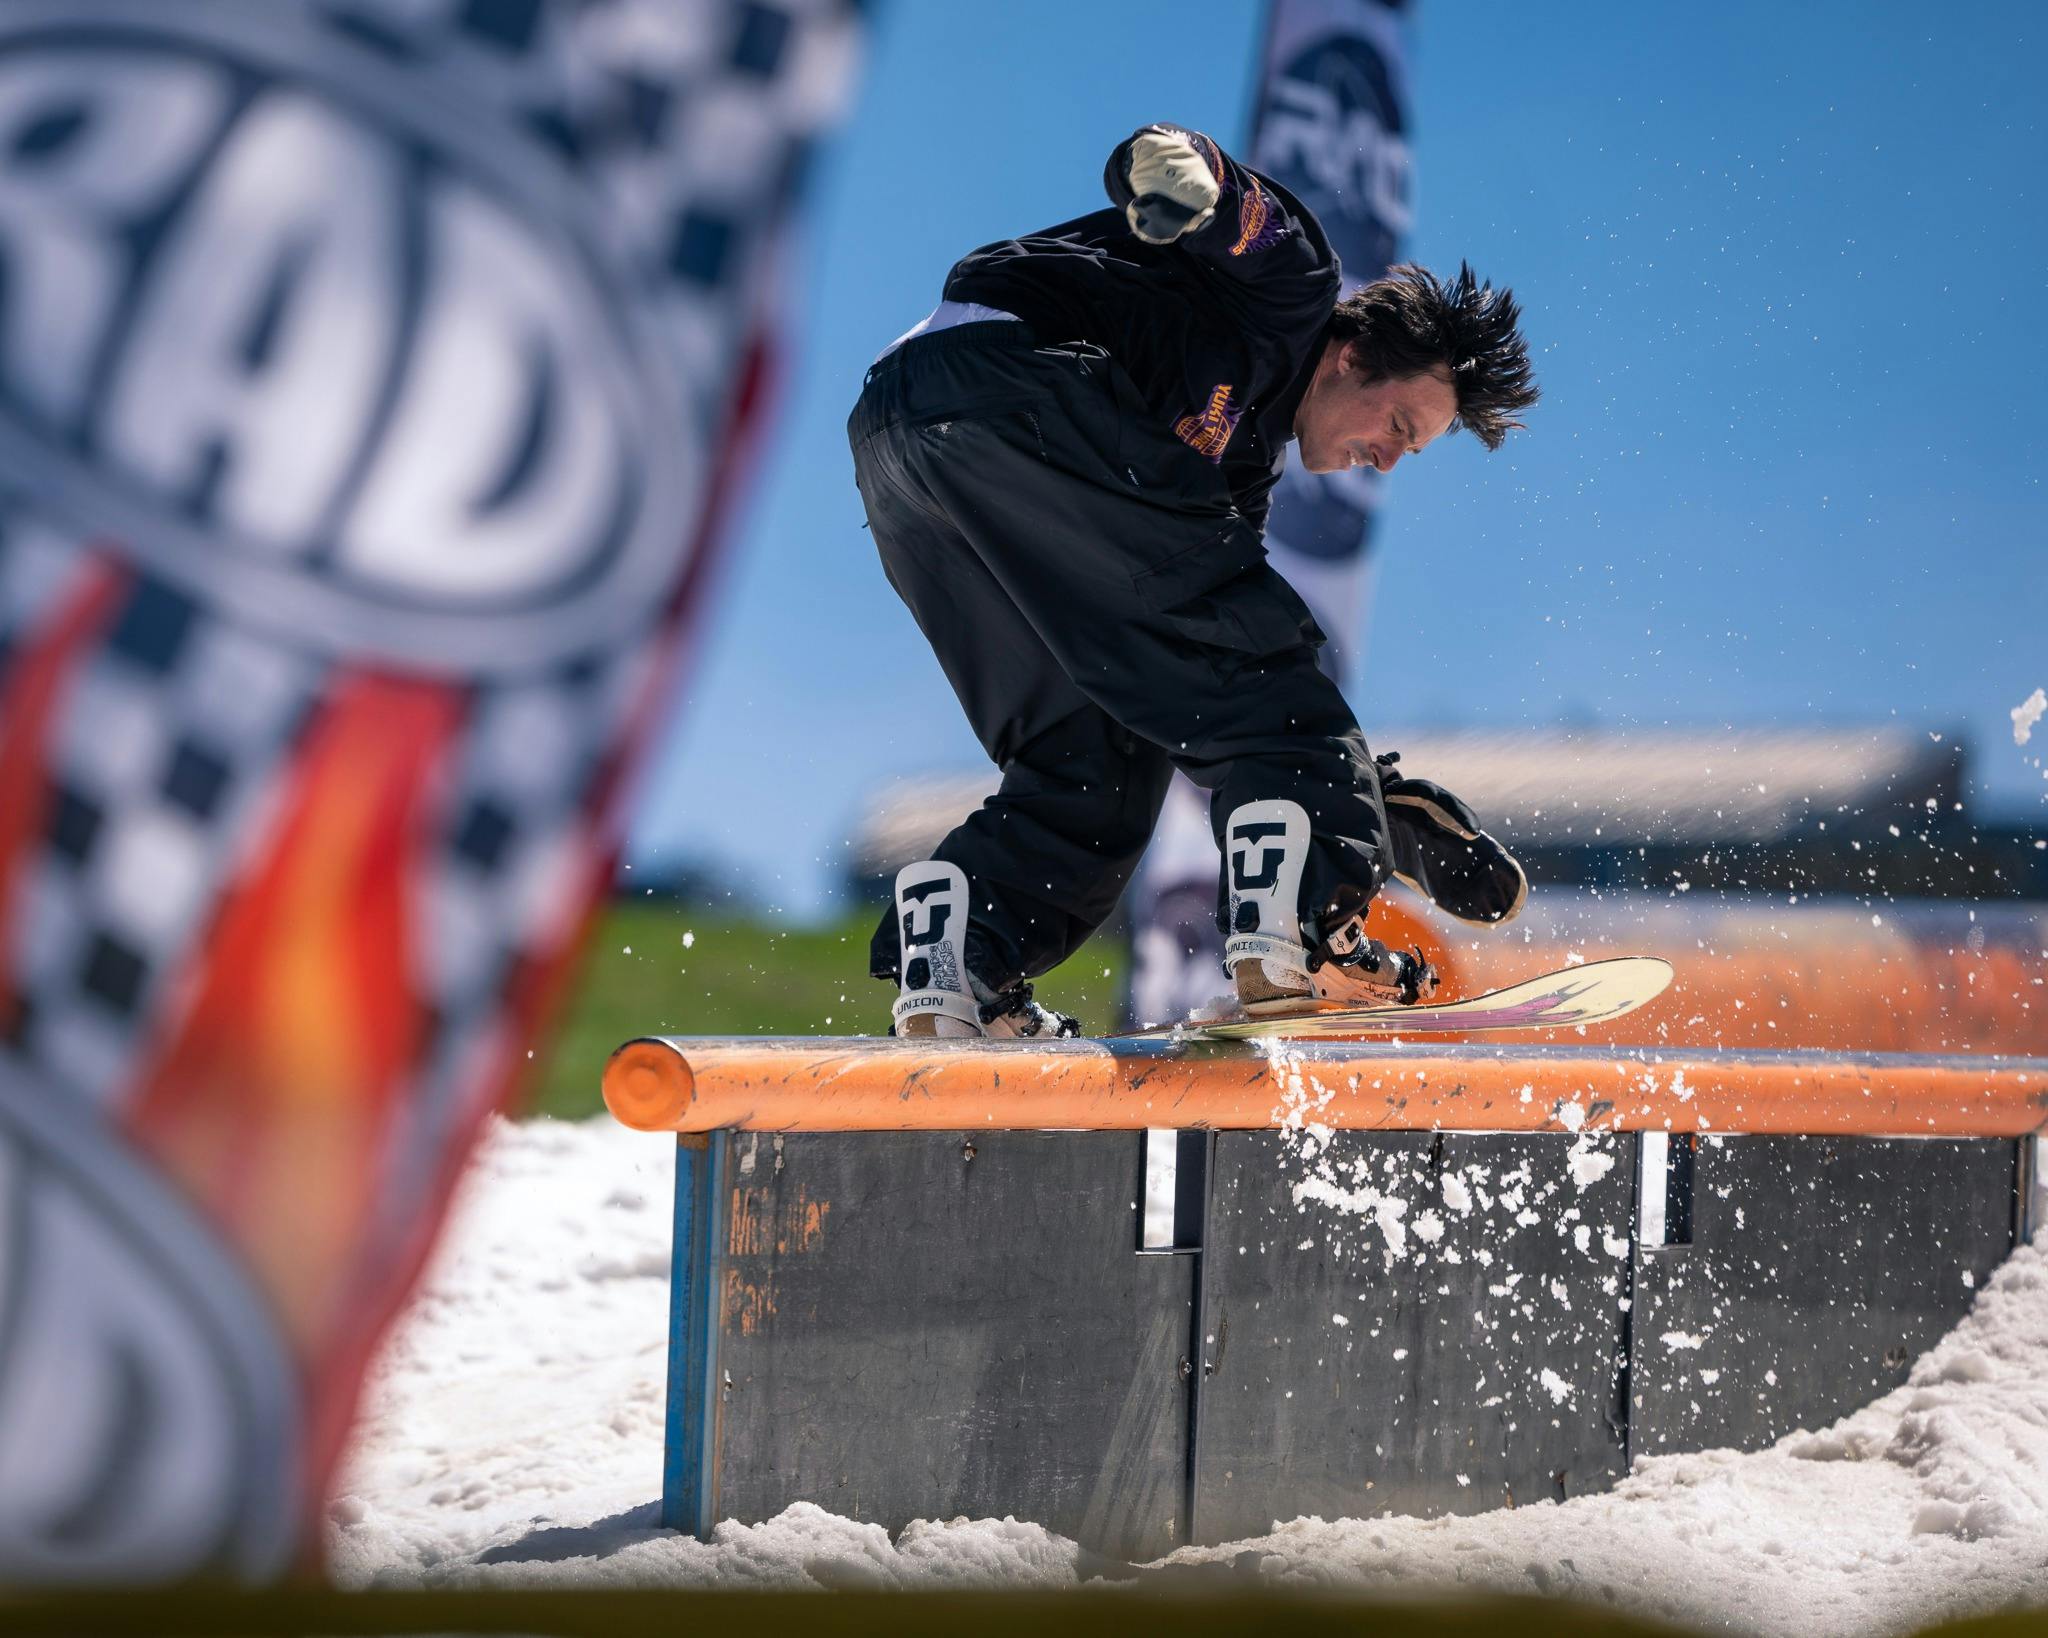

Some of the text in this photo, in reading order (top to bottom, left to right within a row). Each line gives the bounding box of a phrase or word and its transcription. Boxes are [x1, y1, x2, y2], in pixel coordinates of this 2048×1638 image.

[0, 52, 612, 598] RAD
[1208, 384, 1233, 422] YUKI
[897, 997, 944, 1015] UNION
